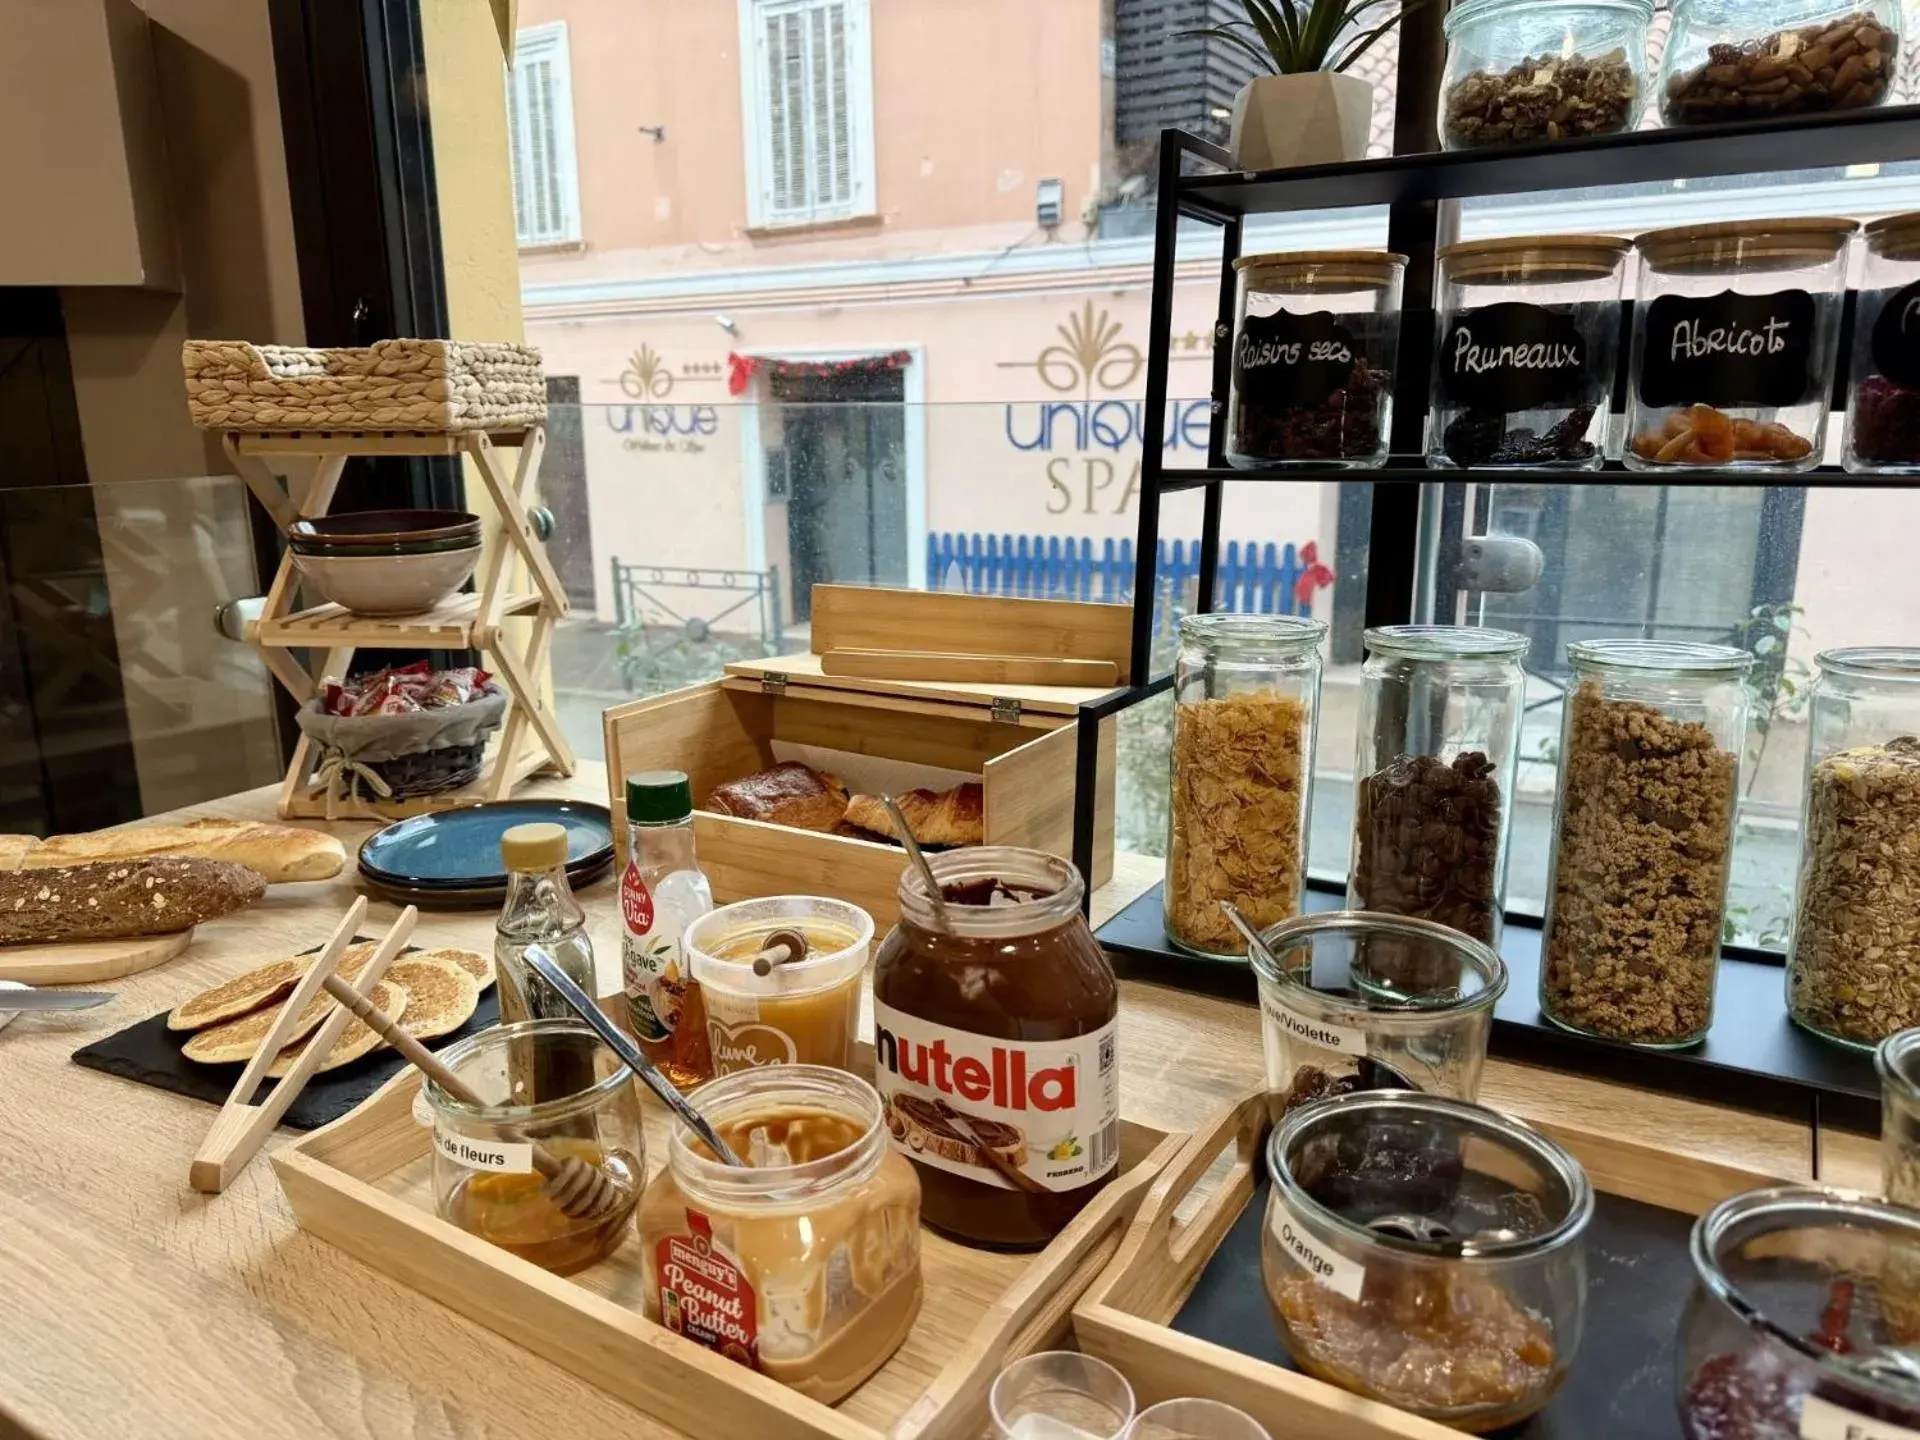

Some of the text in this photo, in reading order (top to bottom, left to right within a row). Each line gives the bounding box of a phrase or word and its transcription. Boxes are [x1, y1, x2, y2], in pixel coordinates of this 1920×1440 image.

[1239, 333, 1352, 369] Raisins secs
[1454, 326, 1580, 374] Pruneaux
[624, 899, 650, 926] Via
[876, 1023, 1077, 1112] nutella
[443, 1138, 505, 1166] de fleurs
[1282, 1223, 1335, 1277] Orange
[664, 1263, 744, 1319] Peanut
[681, 1296, 749, 1344] Butter
